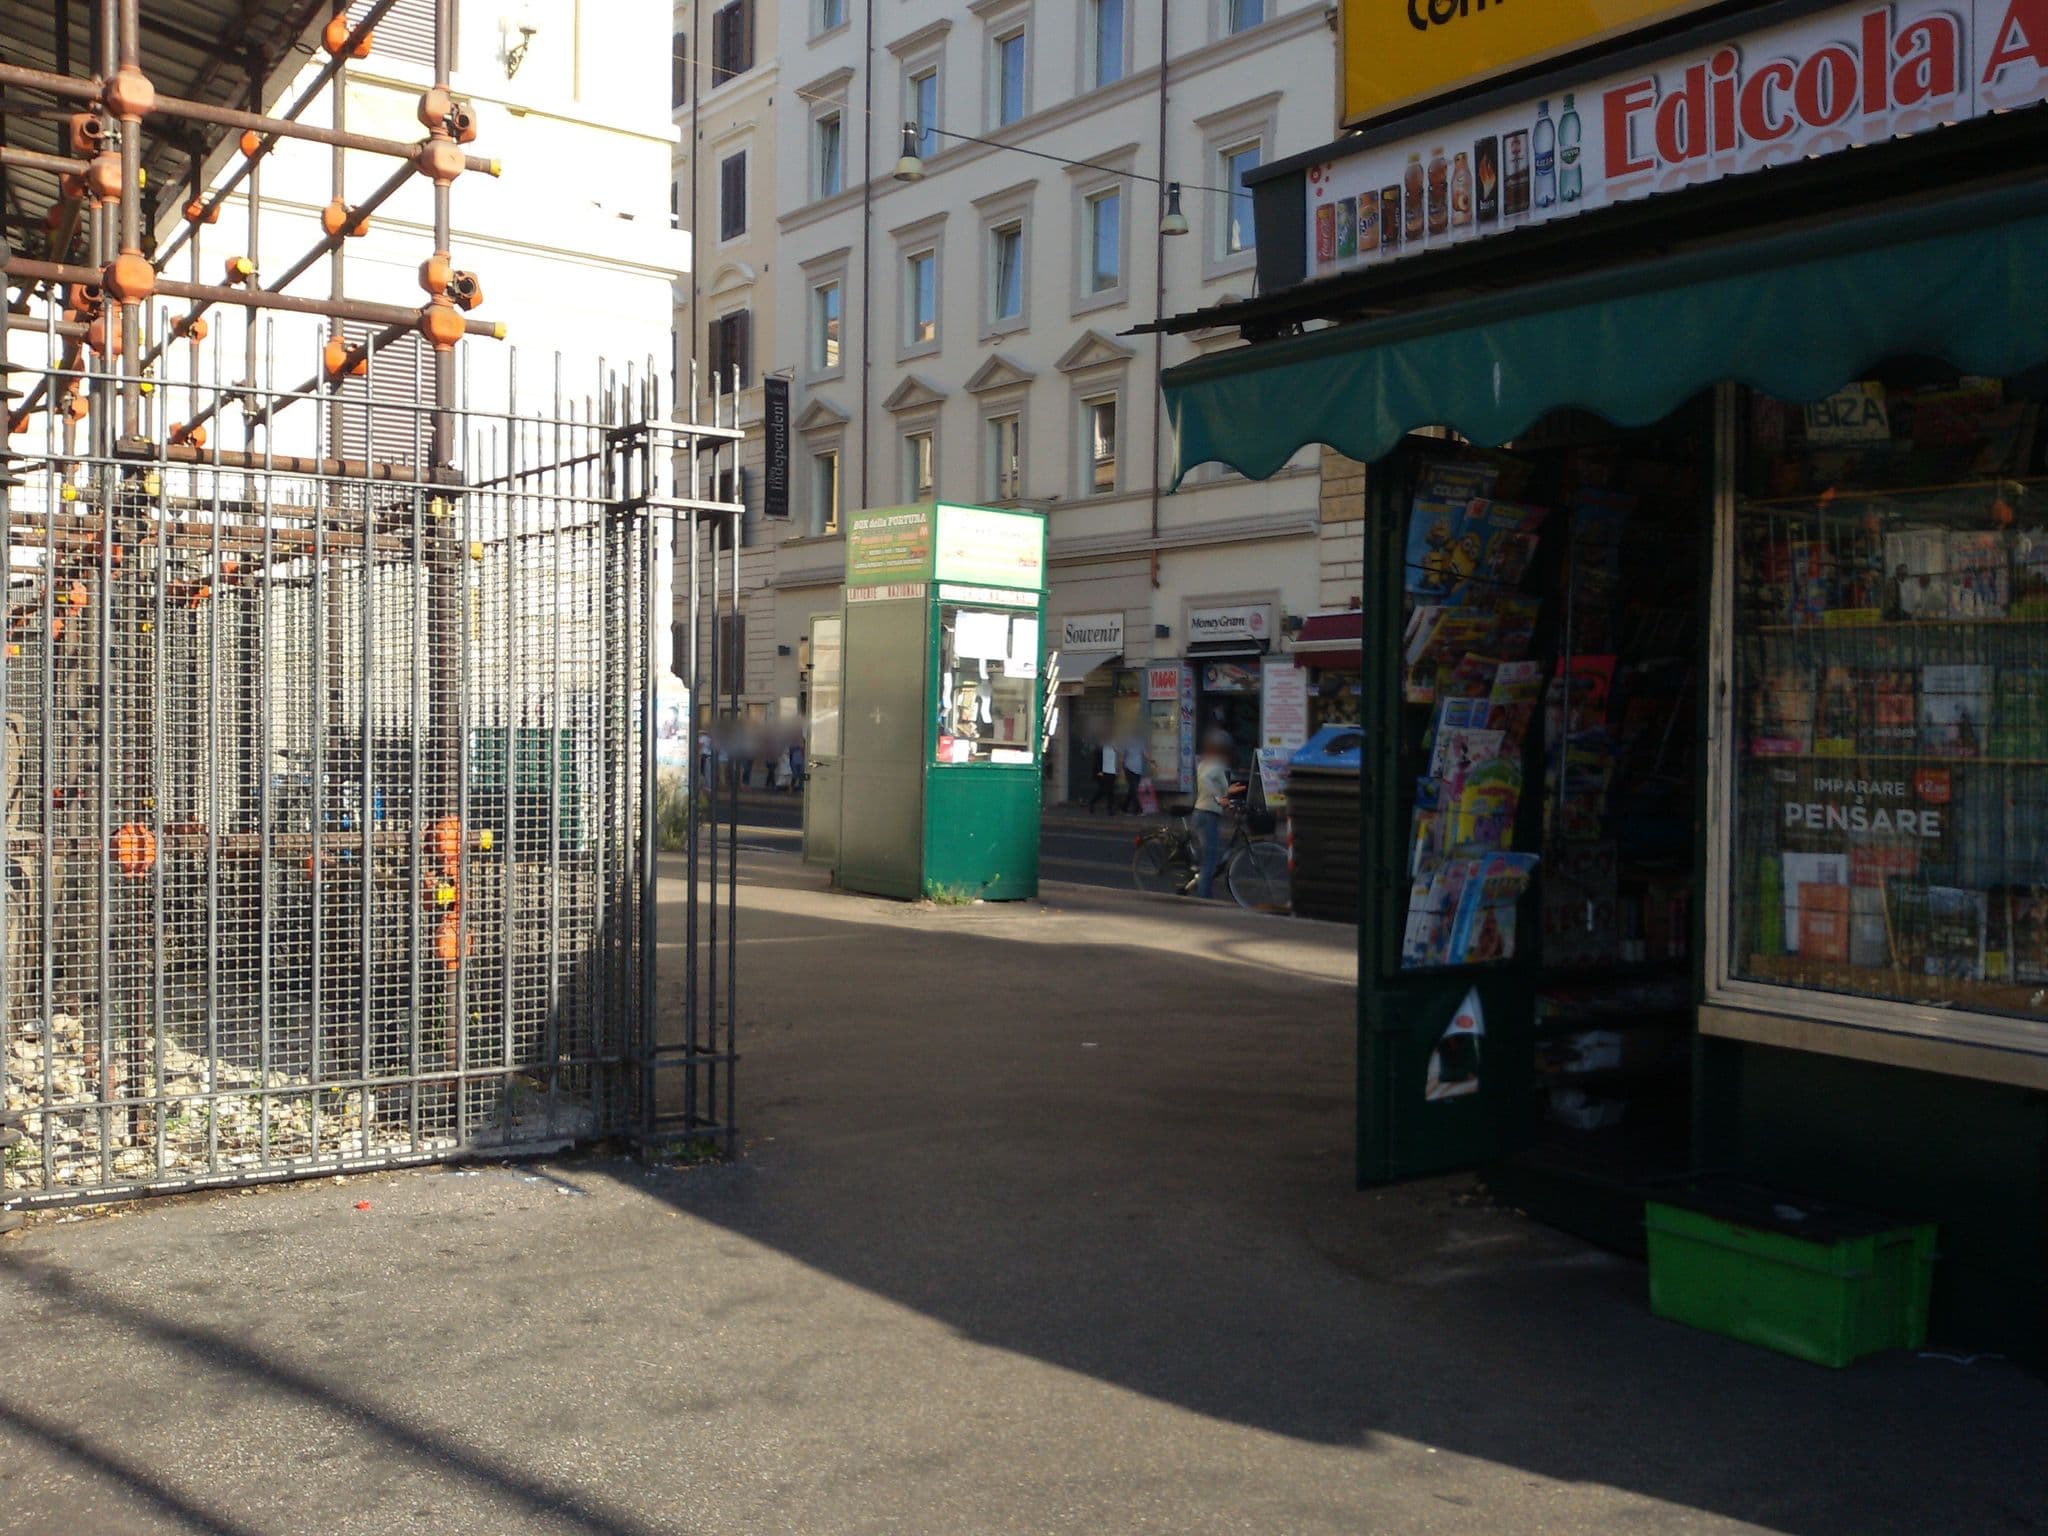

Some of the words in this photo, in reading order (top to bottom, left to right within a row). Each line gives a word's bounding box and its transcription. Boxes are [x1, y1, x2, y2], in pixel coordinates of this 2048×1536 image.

[1601, 8, 1958, 181] Edicola
[1807, 399, 1887, 428] IBIZA
[1064, 621, 1120, 644] Souvenir
[1191, 615, 1246, 630] MoneyGram
[1150, 670, 1177, 689] VIAGGI
[1815, 779, 1905, 797] IMPARARE
[1784, 803, 1941, 837] PENSARE
